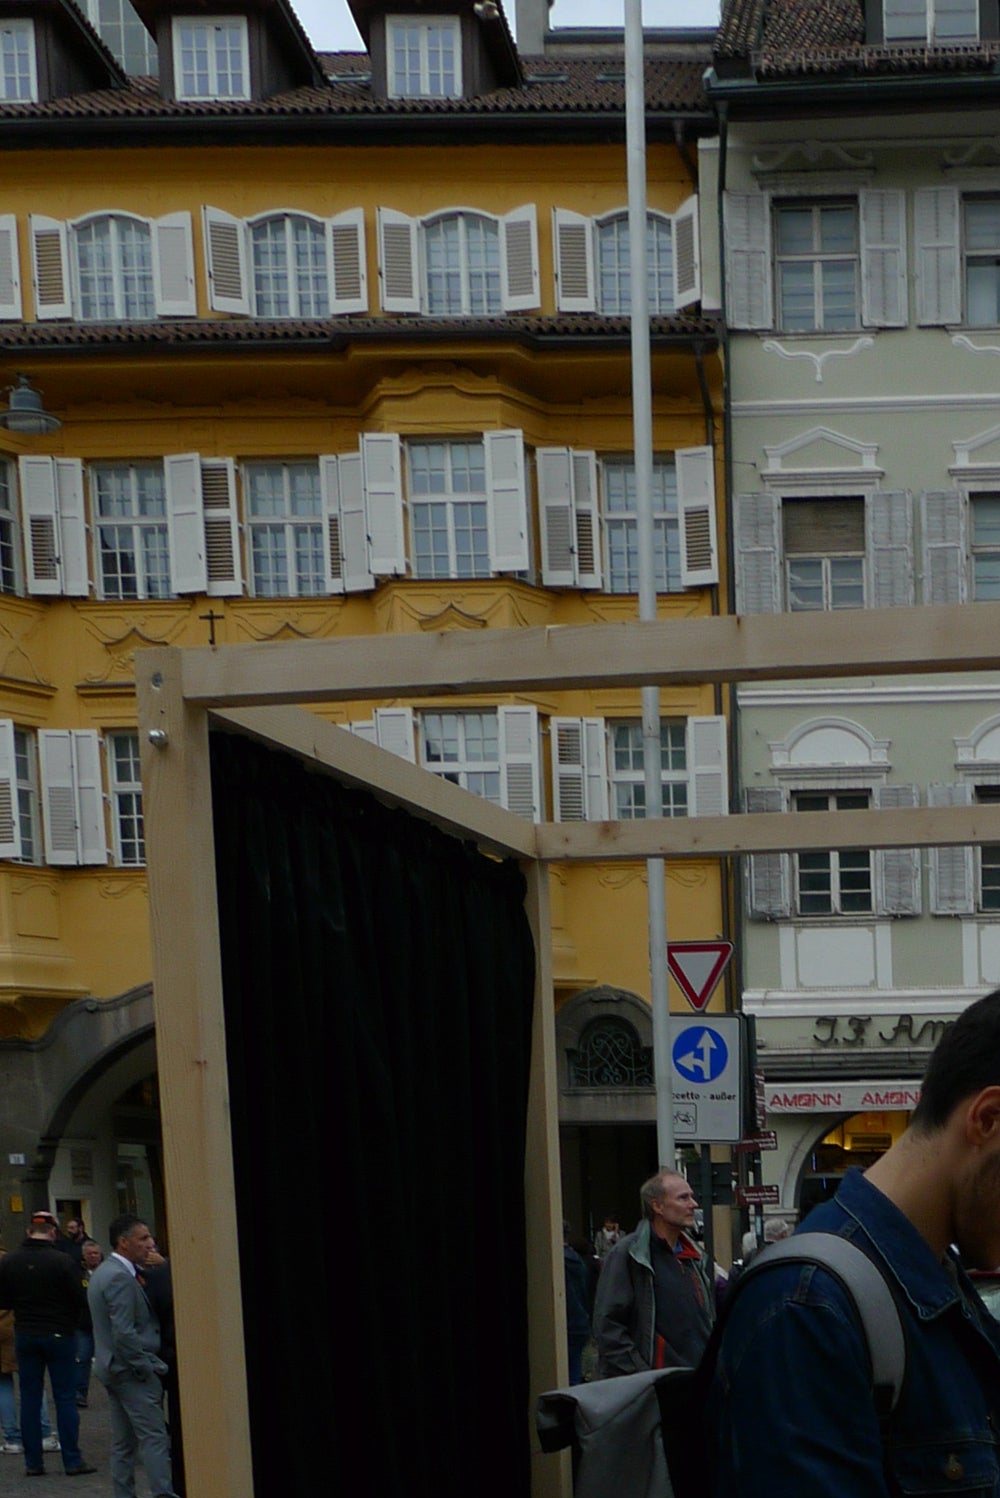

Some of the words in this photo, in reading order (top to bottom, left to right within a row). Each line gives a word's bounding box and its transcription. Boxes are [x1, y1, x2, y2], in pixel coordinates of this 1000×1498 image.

[710, 1091, 737, 1101] außer
[769, 1093, 842, 1108] AMONN
[861, 1090, 923, 1106] AMON
